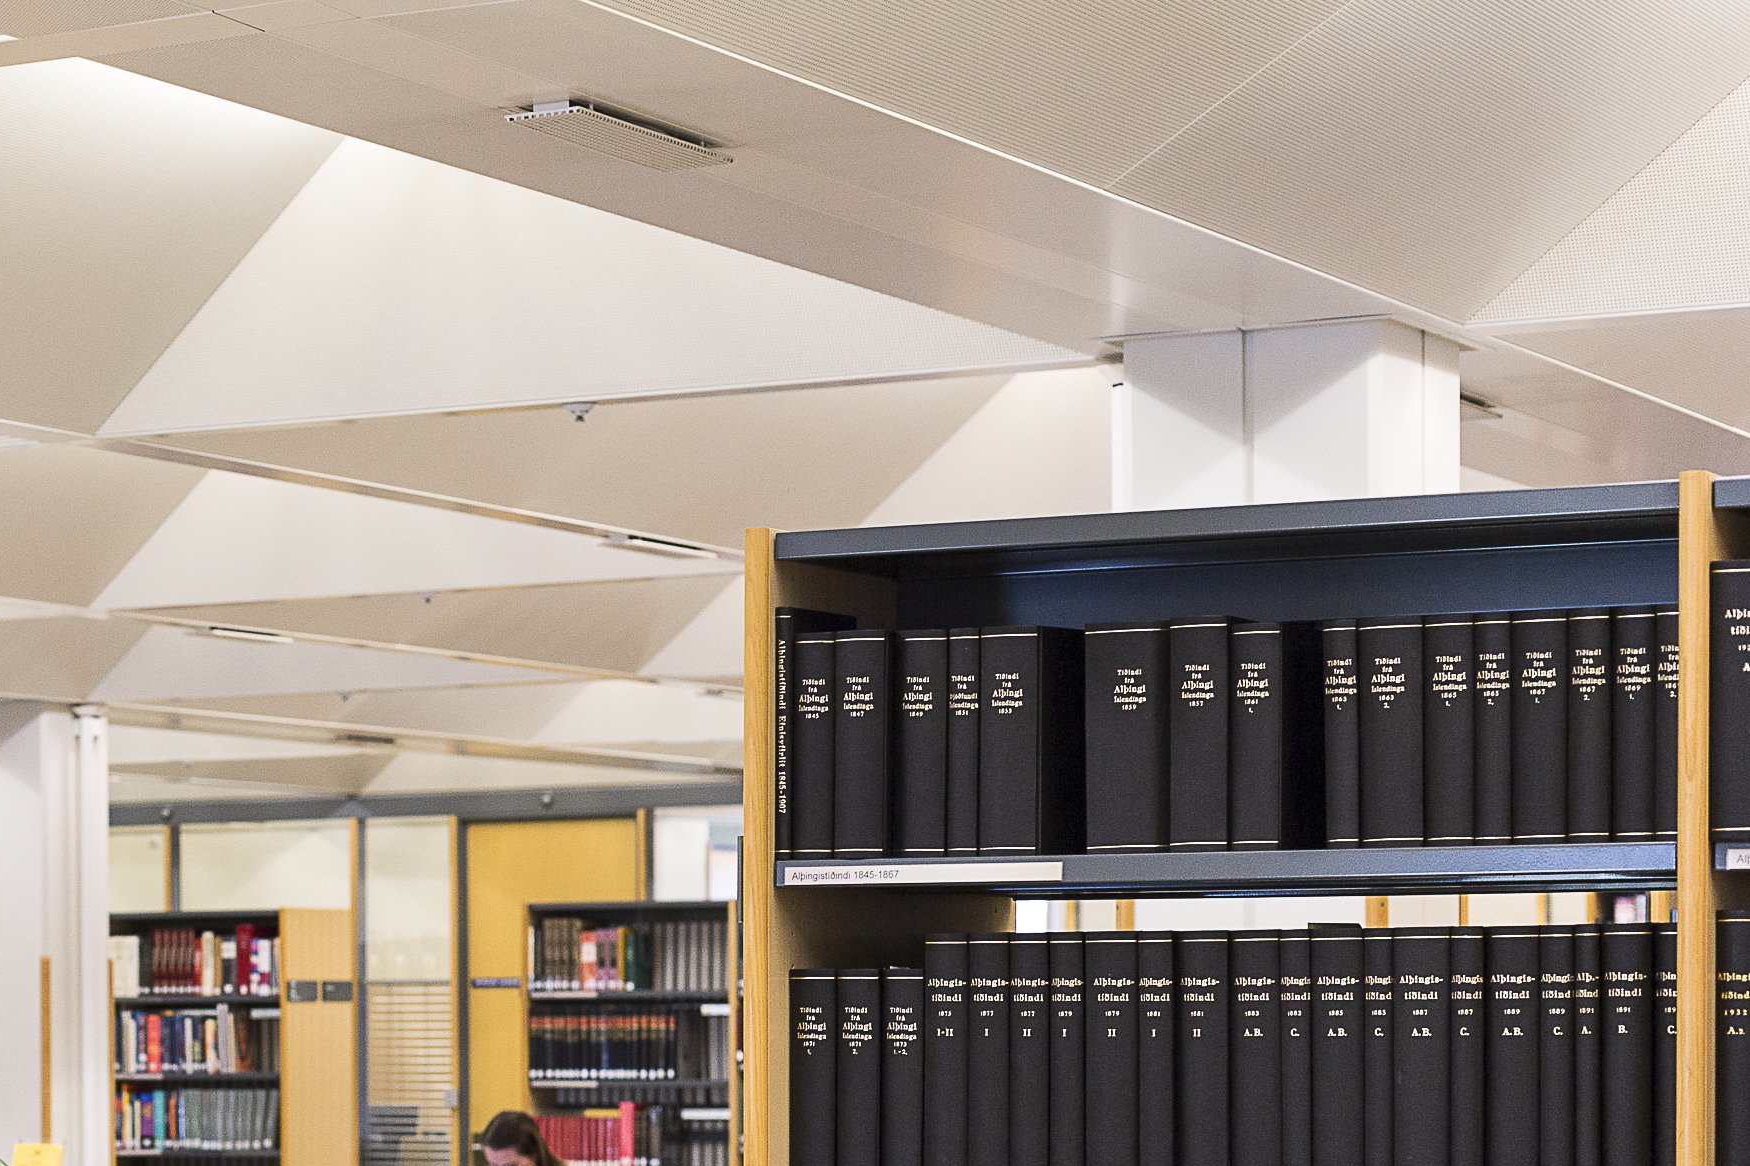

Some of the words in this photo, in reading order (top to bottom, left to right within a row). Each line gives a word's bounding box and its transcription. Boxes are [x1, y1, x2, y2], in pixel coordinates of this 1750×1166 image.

[1114, 685, 1146, 694] Alþingi
[1182, 680, 1213, 690] Alþingi
[799, 695, 828, 703] Alþingi
[844, 692, 873, 701] Alþingi
[792, 871, 850, 882] Alþingistíðindi
[854, 870, 899, 879] 1845-1867
[1094, 978, 1134, 987] Alþingis-
[1400, 975, 1443, 985] Alþingis-
[1491, 974, 1535, 984] Alþingis-
[1108, 1029, 1116, 1037] II
